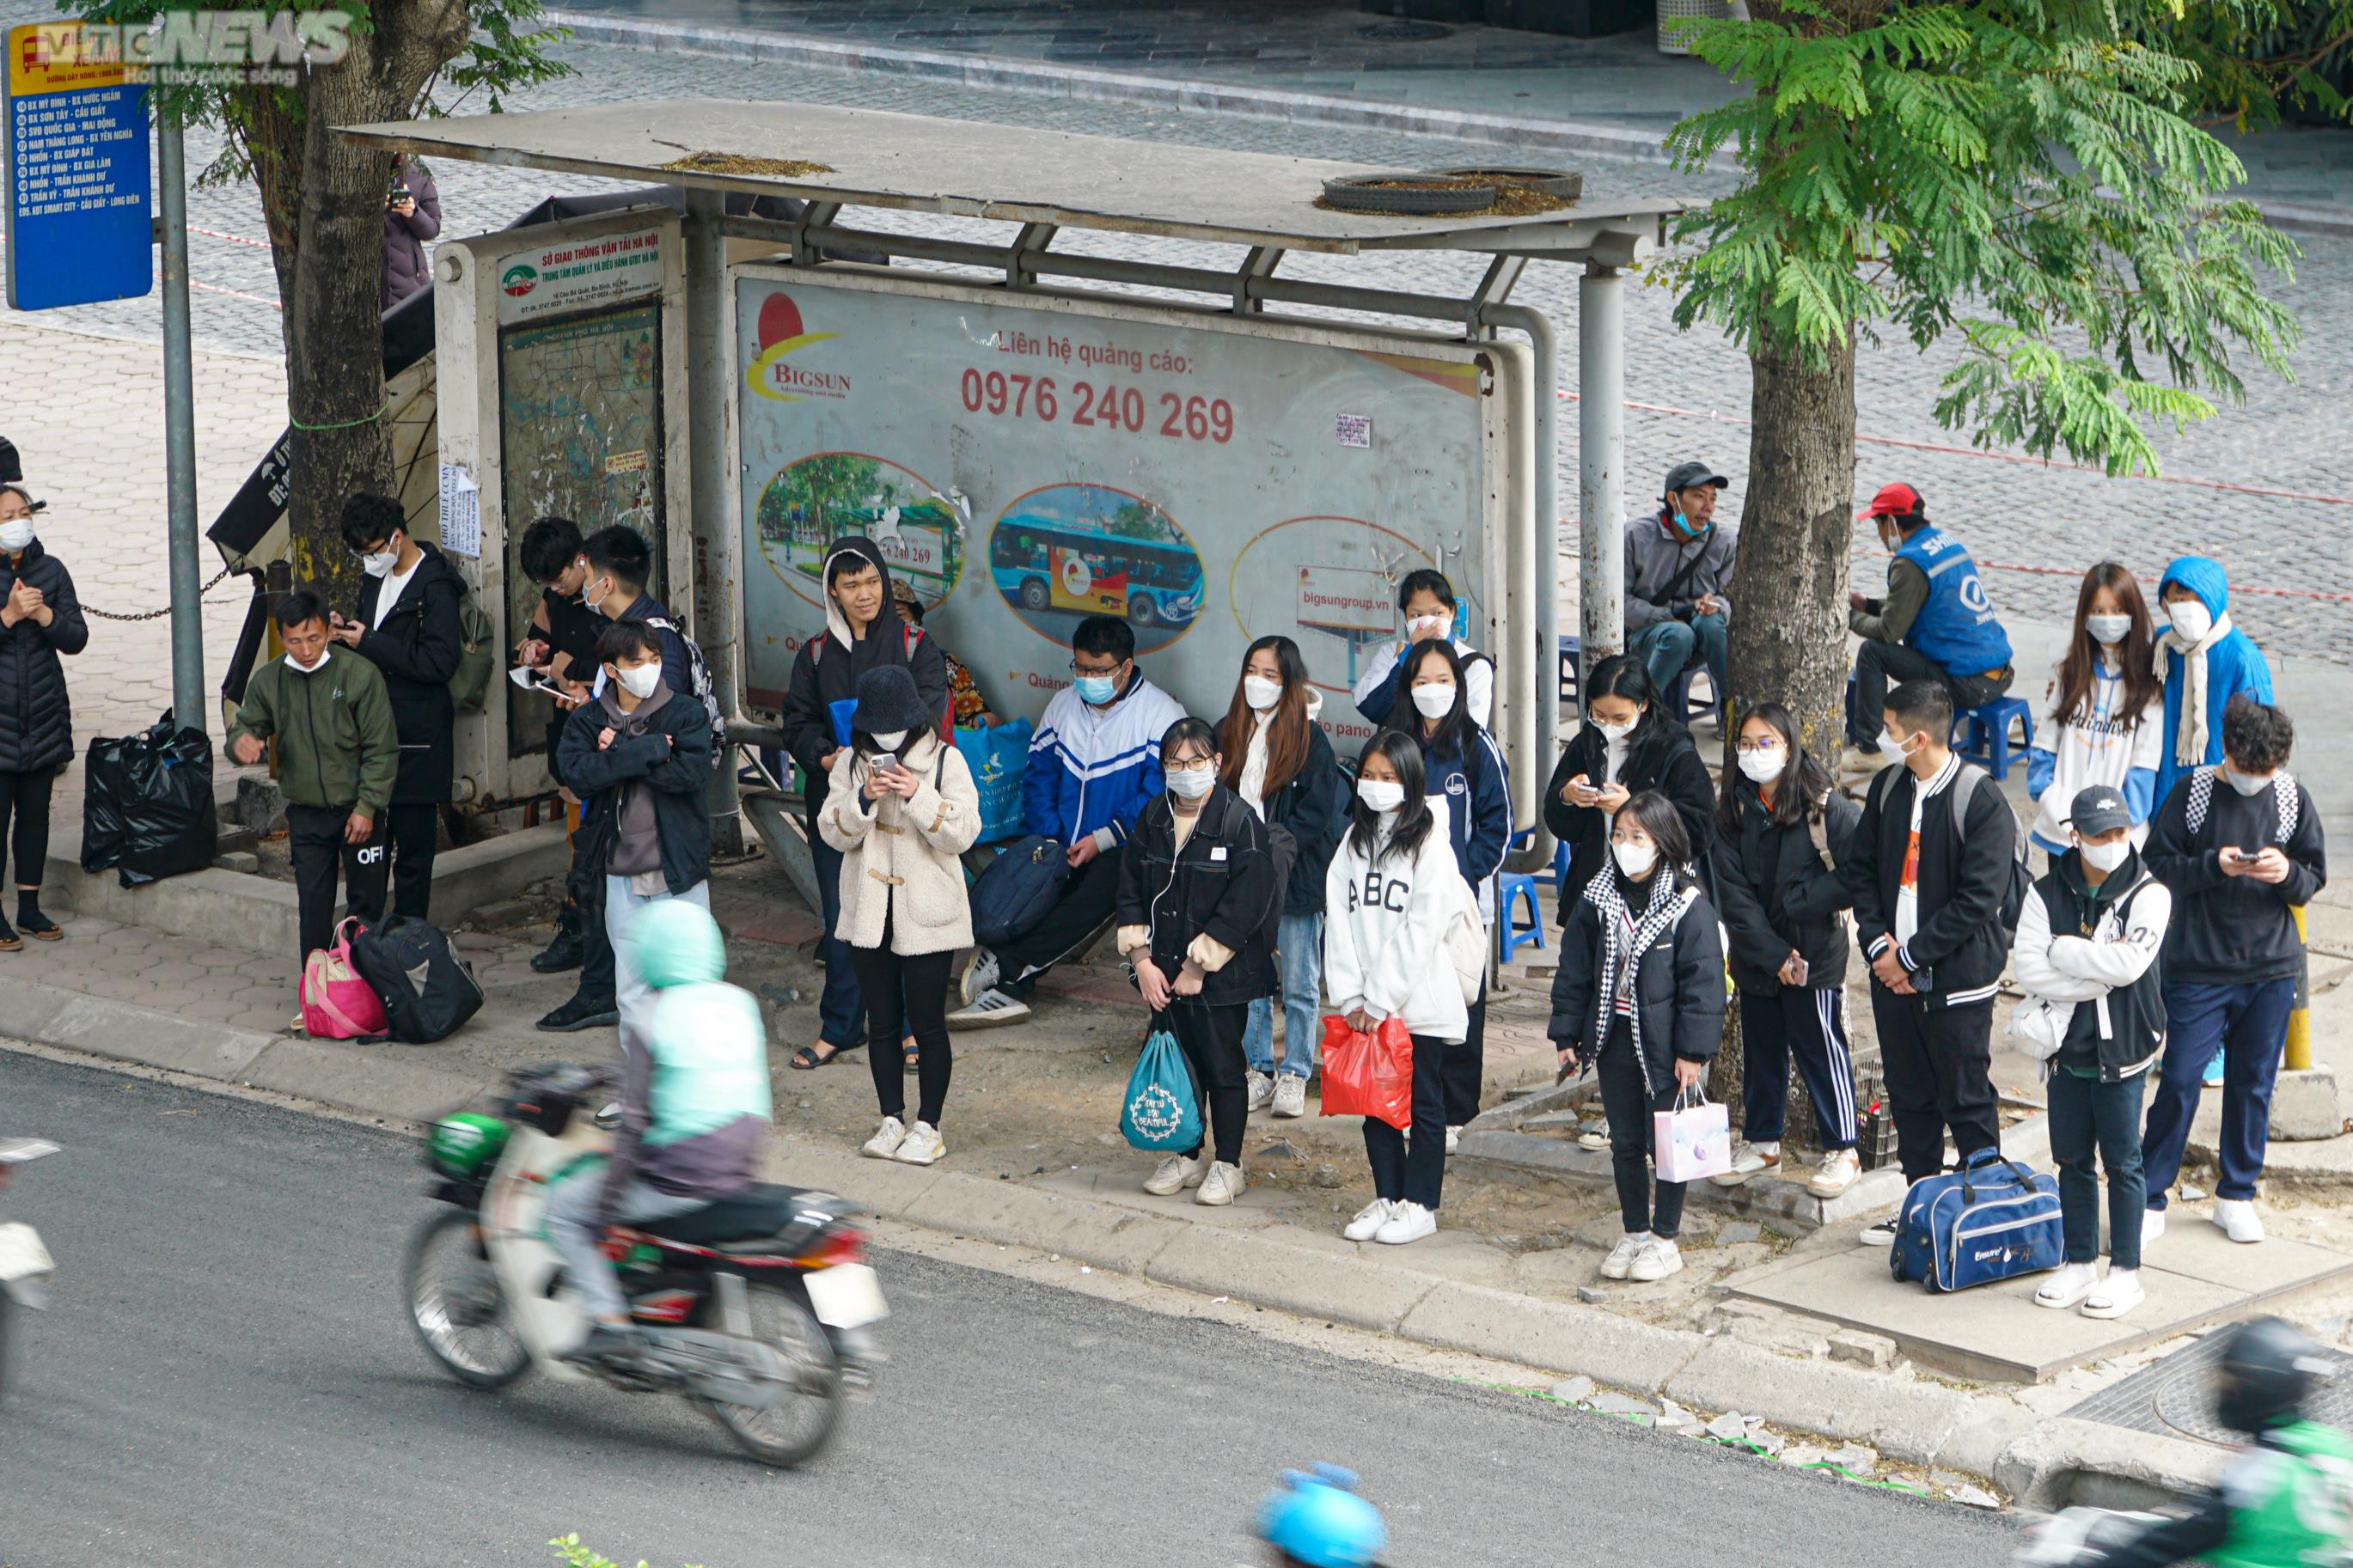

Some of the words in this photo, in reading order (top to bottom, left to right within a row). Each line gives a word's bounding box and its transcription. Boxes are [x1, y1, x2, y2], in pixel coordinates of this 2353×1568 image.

[541, 270, 559, 282] TRUNG
[559, 266, 571, 278] TÂM
[571, 262, 586, 278] QUẢN
[586, 261, 593, 274] LÝ
[593, 259, 601, 272] VÀ
[614, 255, 628, 268] HÀNH
[642, 250, 650, 264] HÀ
[650, 249, 659, 263] NỘI
[542, 250, 553, 266] SỞ
[554, 251, 572, 264] GIAO
[574, 245, 599, 260] THÔNG
[602, 241, 617, 256] VẬN
[619, 235, 631, 251] TẢI
[633, 234, 643, 249] HÀ
[645, 232, 658, 247] NỘI
[998, 329, 1041, 357] Liên
[1048, 335, 1073, 364] hệ
[1078, 340, 1143, 374] quảng
[1149, 349, 1194, 375] cáo:
[961, 367, 1059, 422] 0976
[1072, 381, 1146, 433] 240
[1159, 392, 1235, 444] 269
[441, 524, 449, 546] CHO
[913, 548, 932, 564] 269
[1303, 590, 1390, 612] bigsungroup.vn
[1336, 723, 1371, 740] pano
[1349, 872, 1409, 913] ABC
